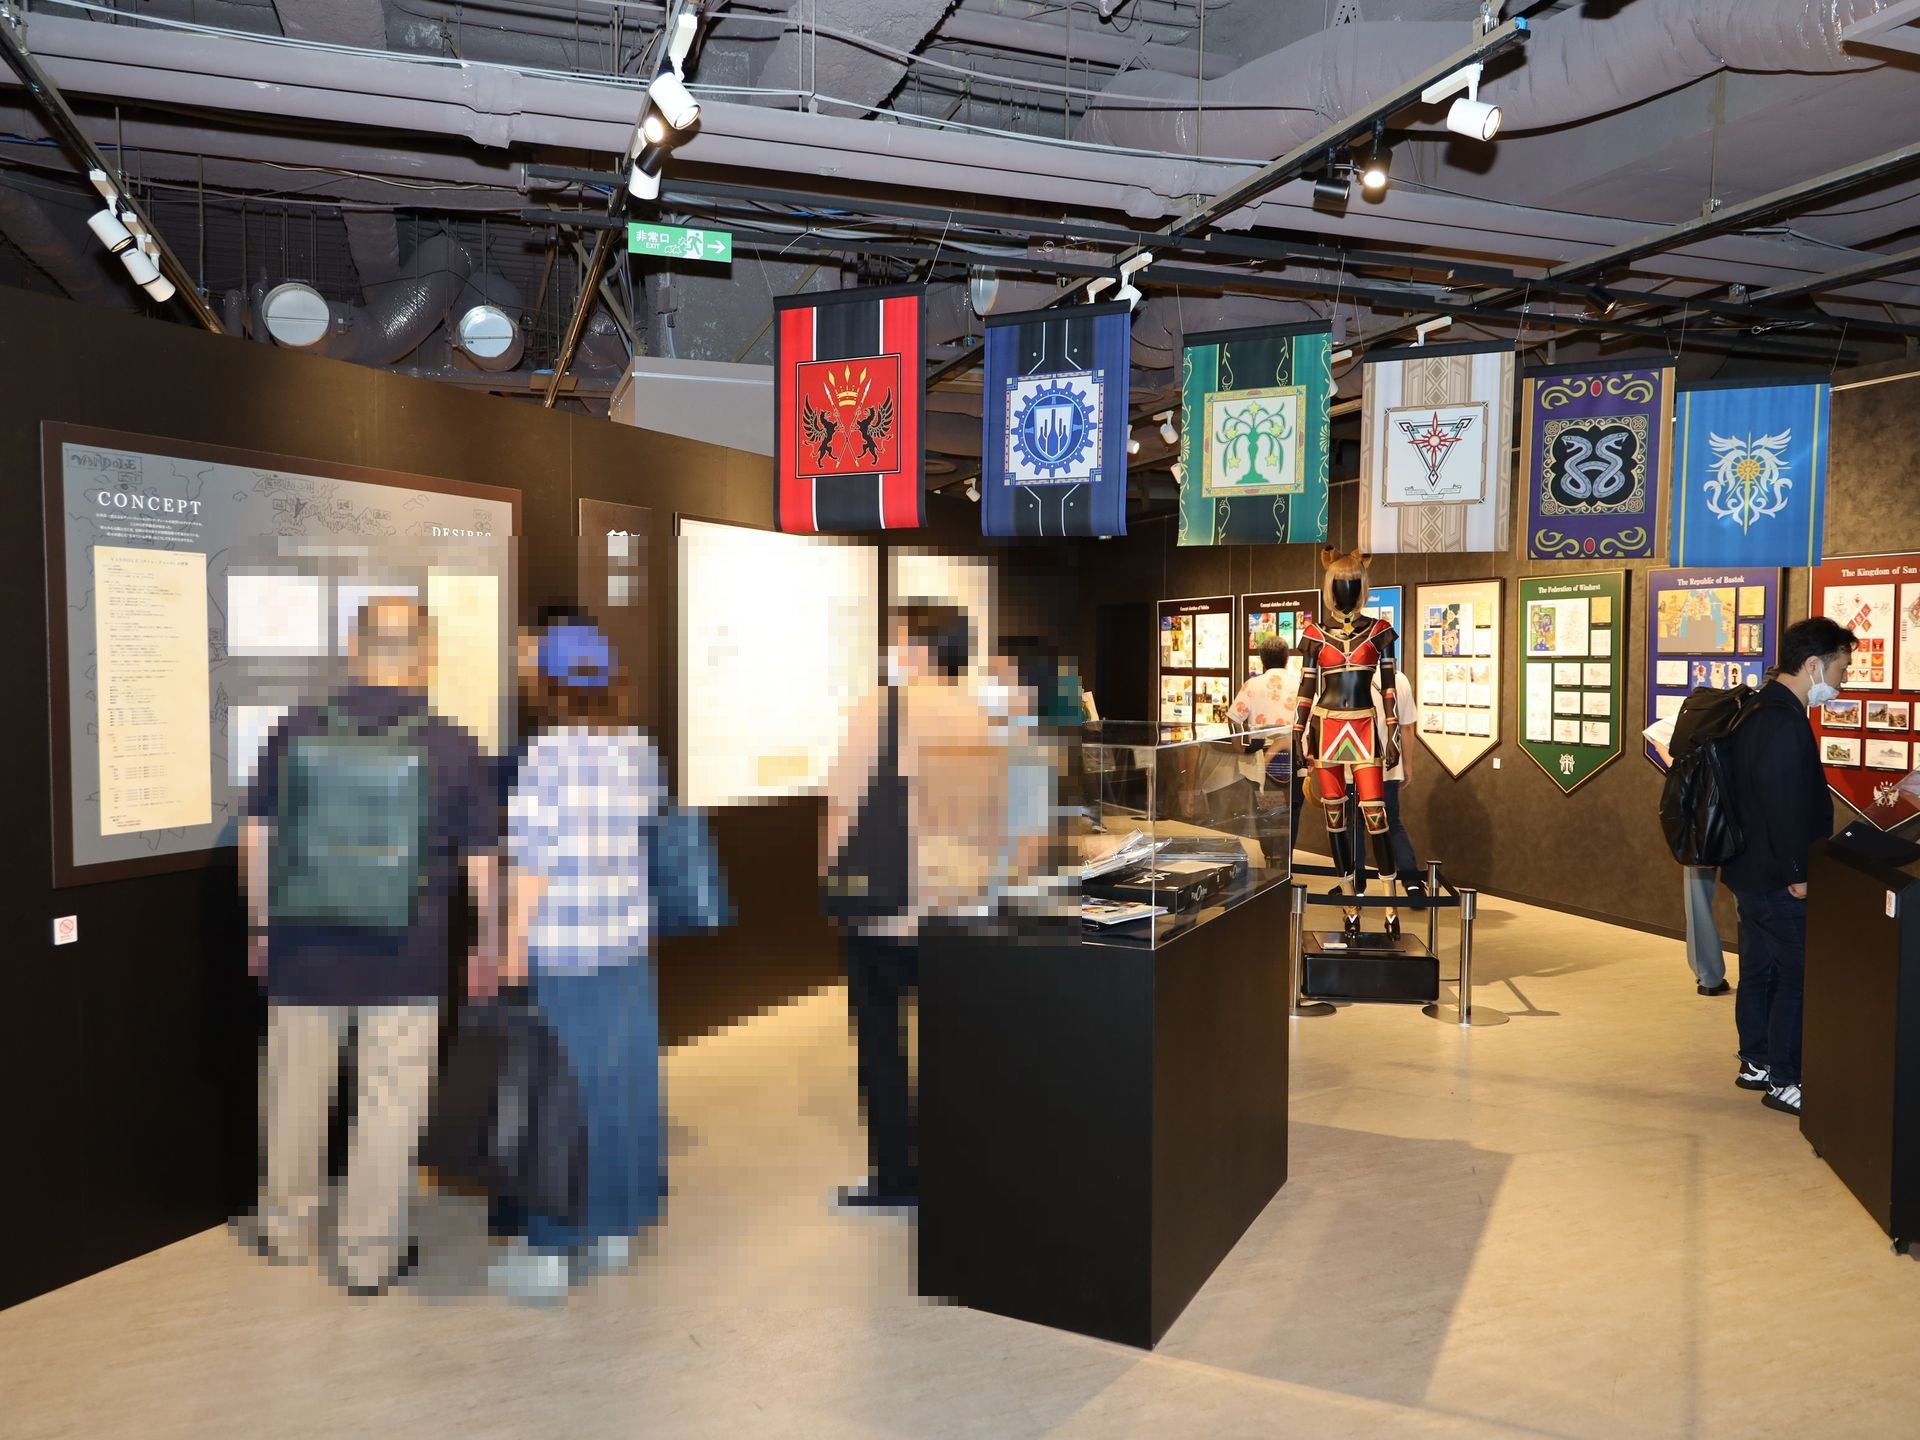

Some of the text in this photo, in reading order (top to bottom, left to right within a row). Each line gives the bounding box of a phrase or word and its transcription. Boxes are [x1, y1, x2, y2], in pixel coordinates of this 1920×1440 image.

[636, 230, 670, 244] 非常口
[97, 491, 202, 515] CONCEPT
[1841, 566, 1917, 577] The Kingdom of San
[1689, 577, 1714, 586] Republic
[1715, 576, 1723, 584] of
